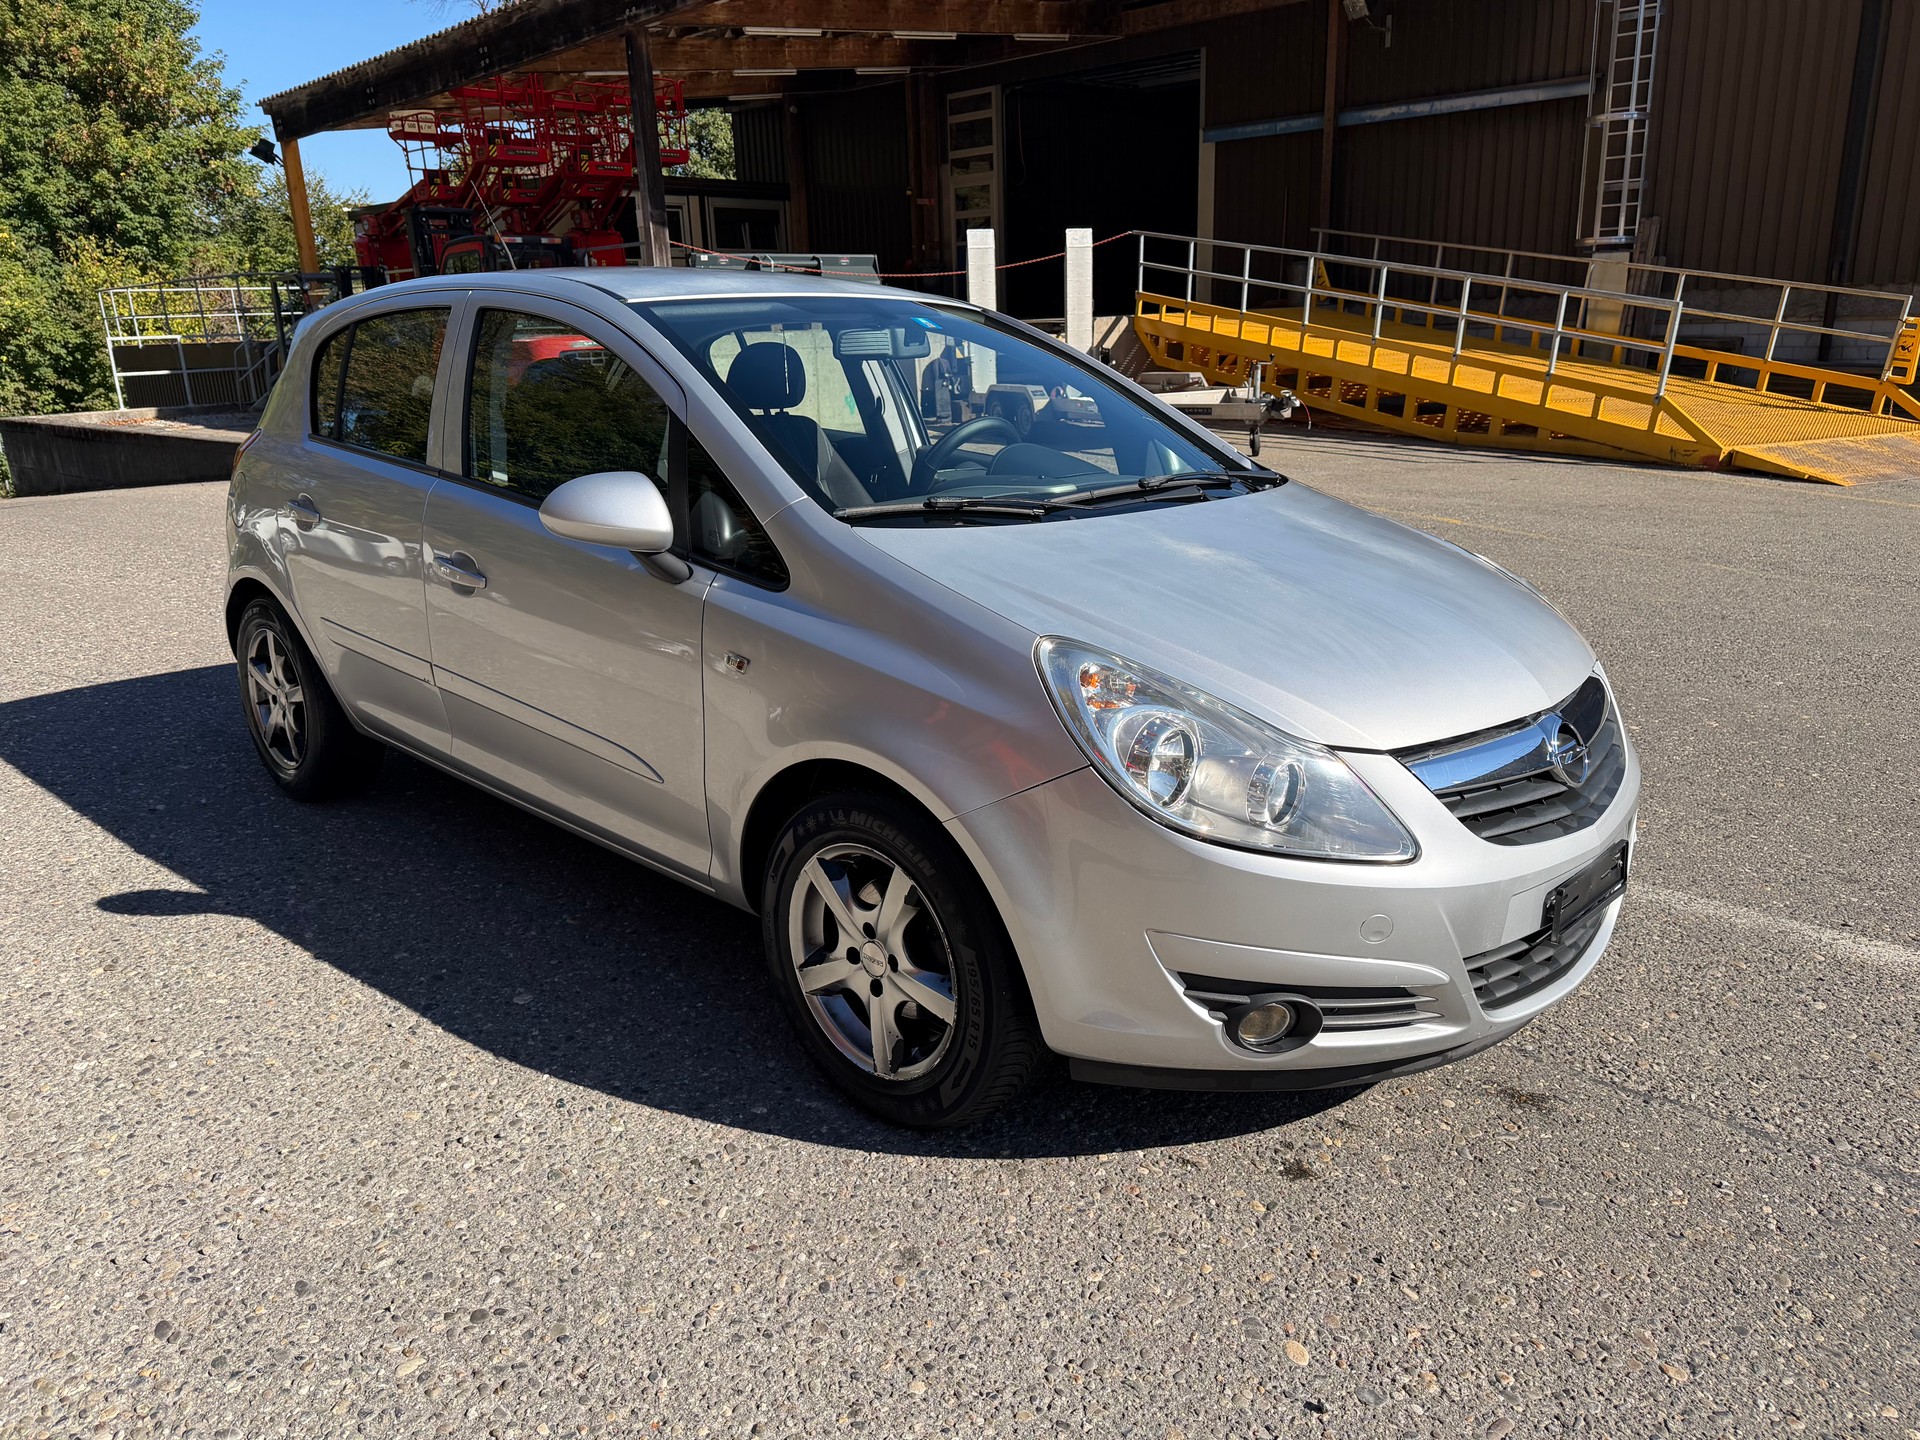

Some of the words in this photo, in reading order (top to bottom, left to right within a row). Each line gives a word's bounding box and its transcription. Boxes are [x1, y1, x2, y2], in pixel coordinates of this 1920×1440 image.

[849, 810, 936, 877] MICHELIN
[966, 960, 981, 1017] 195/65
[968, 1032, 979, 1050] 15
[970, 1020, 980, 1031] R
